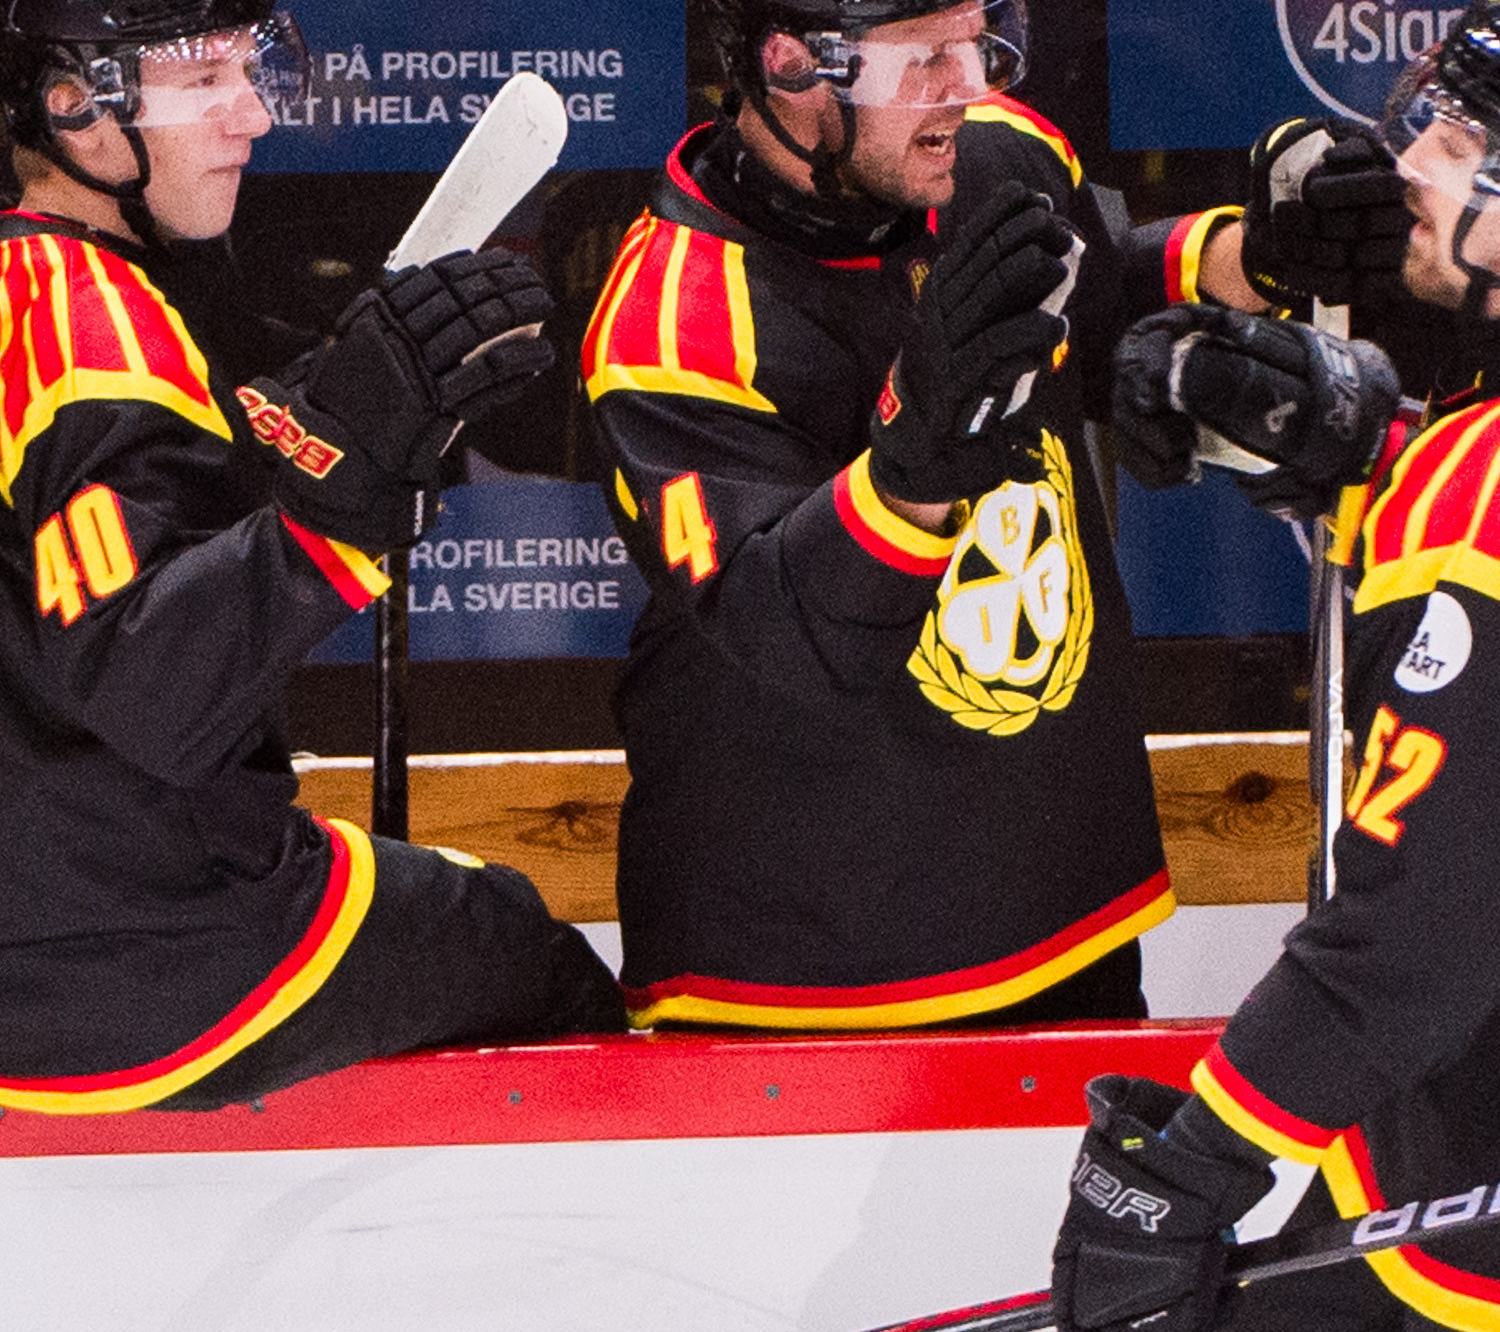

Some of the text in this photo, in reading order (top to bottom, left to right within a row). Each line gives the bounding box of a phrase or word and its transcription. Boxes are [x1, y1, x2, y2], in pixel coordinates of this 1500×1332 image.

[324, 42, 372, 82] PÅ
[353, 94, 450, 125] HELA
[462, 95, 615, 126] SVGE
[660, 470, 719, 585] 4
[998, 505, 1021, 547] B
[33, 482, 139, 626] 40
[408, 537, 628, 570] ROFILERING
[464, 581, 620, 612] SVERIGE
